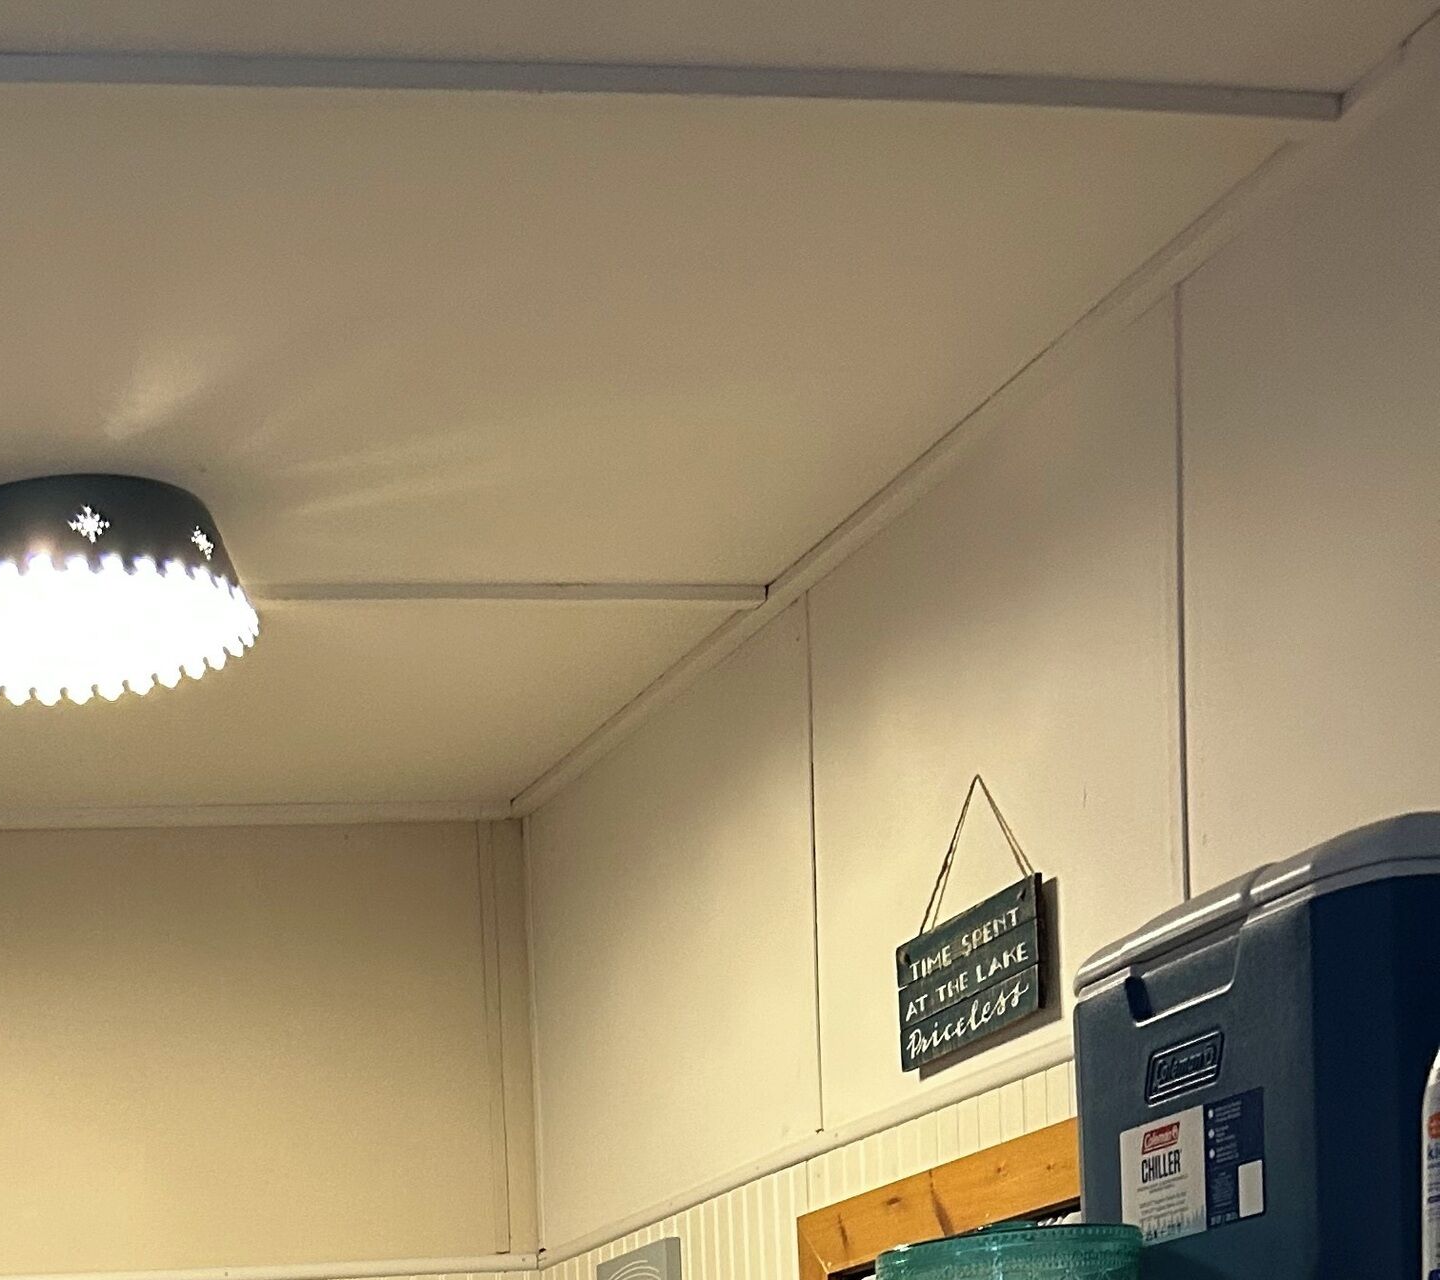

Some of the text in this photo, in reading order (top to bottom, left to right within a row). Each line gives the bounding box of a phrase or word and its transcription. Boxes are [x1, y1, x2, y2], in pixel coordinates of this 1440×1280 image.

[905, 941, 1029, 1022] AT THE LAKE
[909, 906, 1020, 982] TIME SPENT
[906, 980, 1030, 1060] Priceless
[1141, 1149, 1181, 1184] CHILLER
